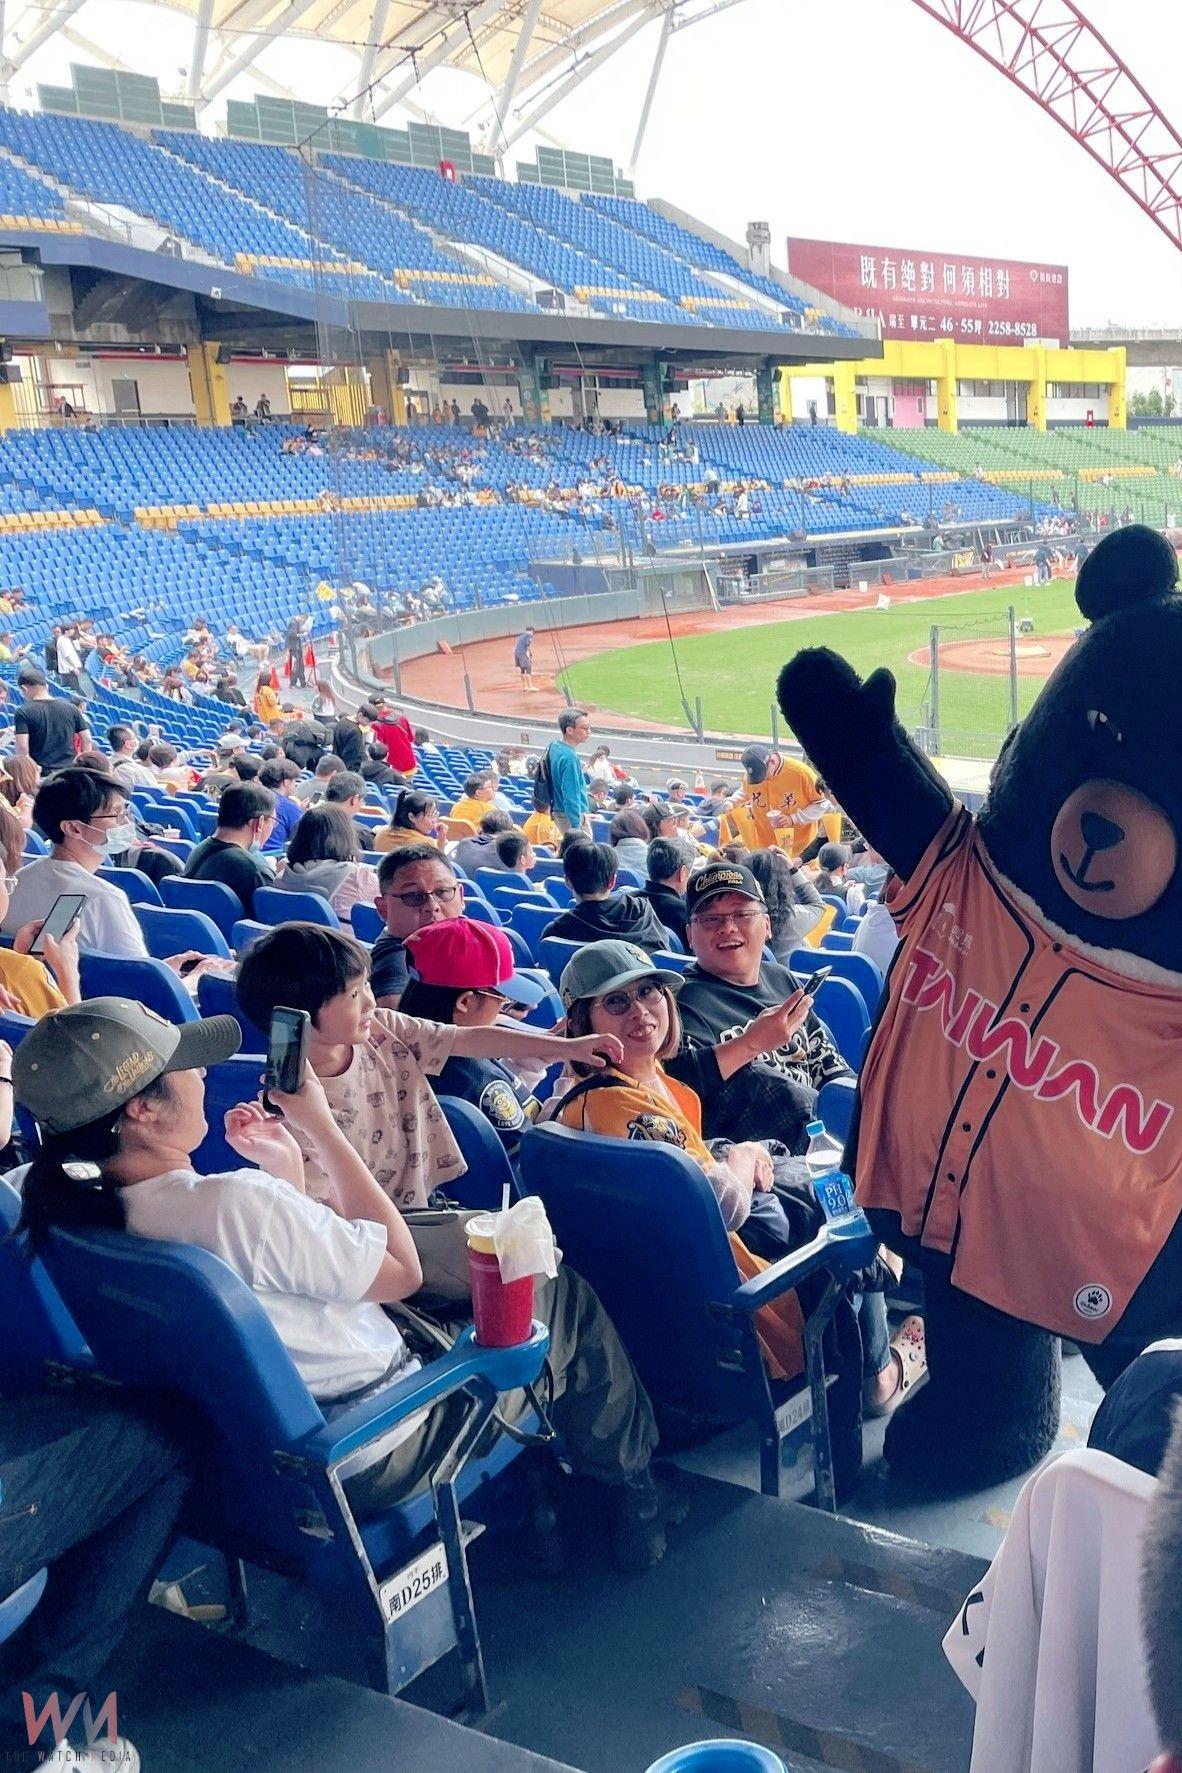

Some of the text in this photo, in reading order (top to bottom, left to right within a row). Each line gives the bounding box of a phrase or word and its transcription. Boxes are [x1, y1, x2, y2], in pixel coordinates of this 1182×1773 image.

[943, 262, 1010, 299] 何須相對
[988, 319, 1037, 336] 2258-8528
[900, 945, 1174, 1155] TAIWAN
[389, 1561, 443, 1616] 南D25排
